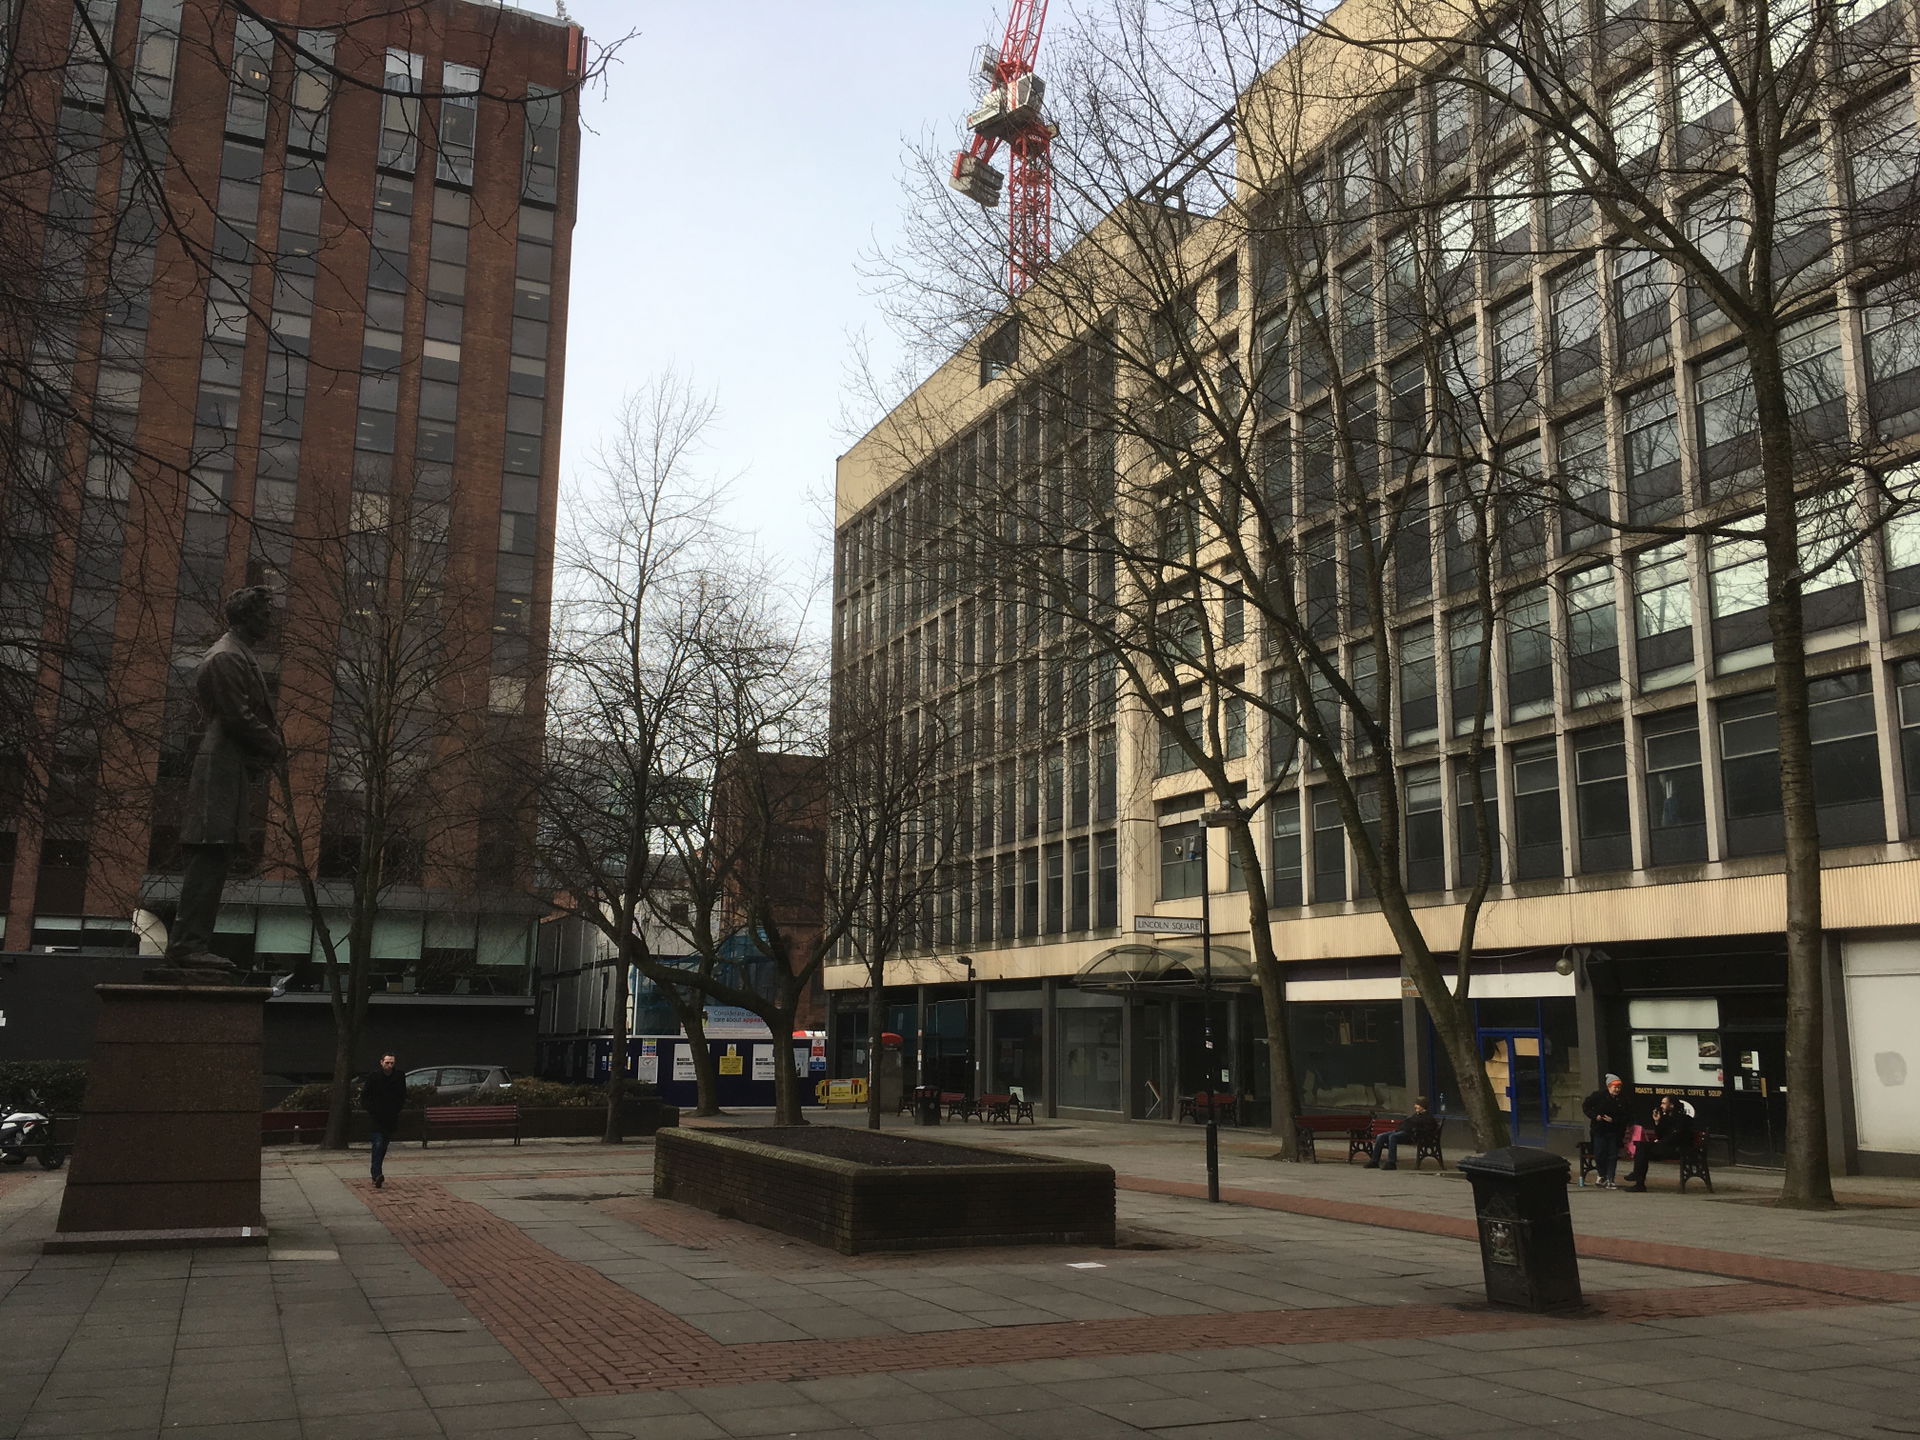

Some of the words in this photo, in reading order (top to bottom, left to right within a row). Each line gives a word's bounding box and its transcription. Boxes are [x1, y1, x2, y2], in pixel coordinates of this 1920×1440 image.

[1138, 920, 1169, 929] LINCOLN
[1171, 922, 1200, 931] SQUARE
[1655, 1087, 1684, 1095] BREAKFASTS
